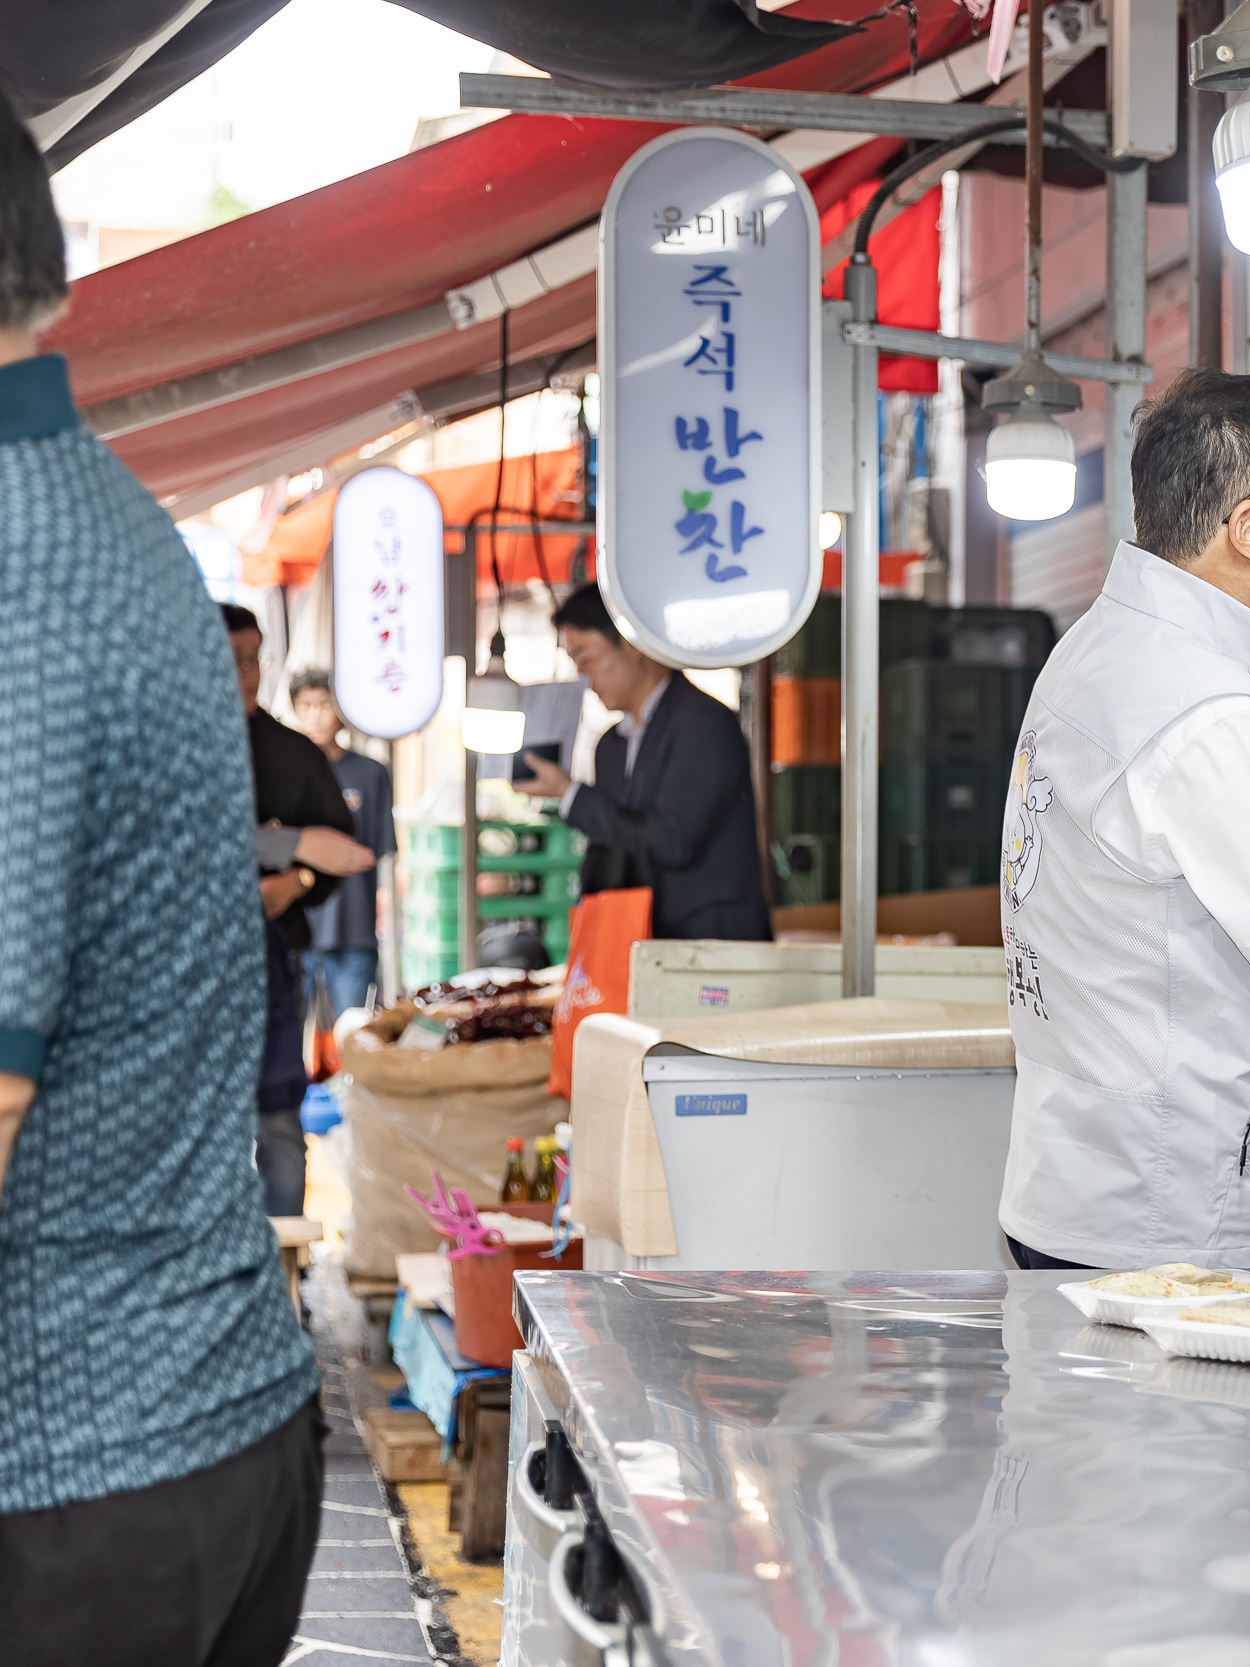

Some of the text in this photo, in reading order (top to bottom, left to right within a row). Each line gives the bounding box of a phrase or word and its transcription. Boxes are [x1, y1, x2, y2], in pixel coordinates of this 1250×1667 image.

[654, 205, 767, 249] 윤미네
[673, 263, 766, 583] 즉석 반찬
